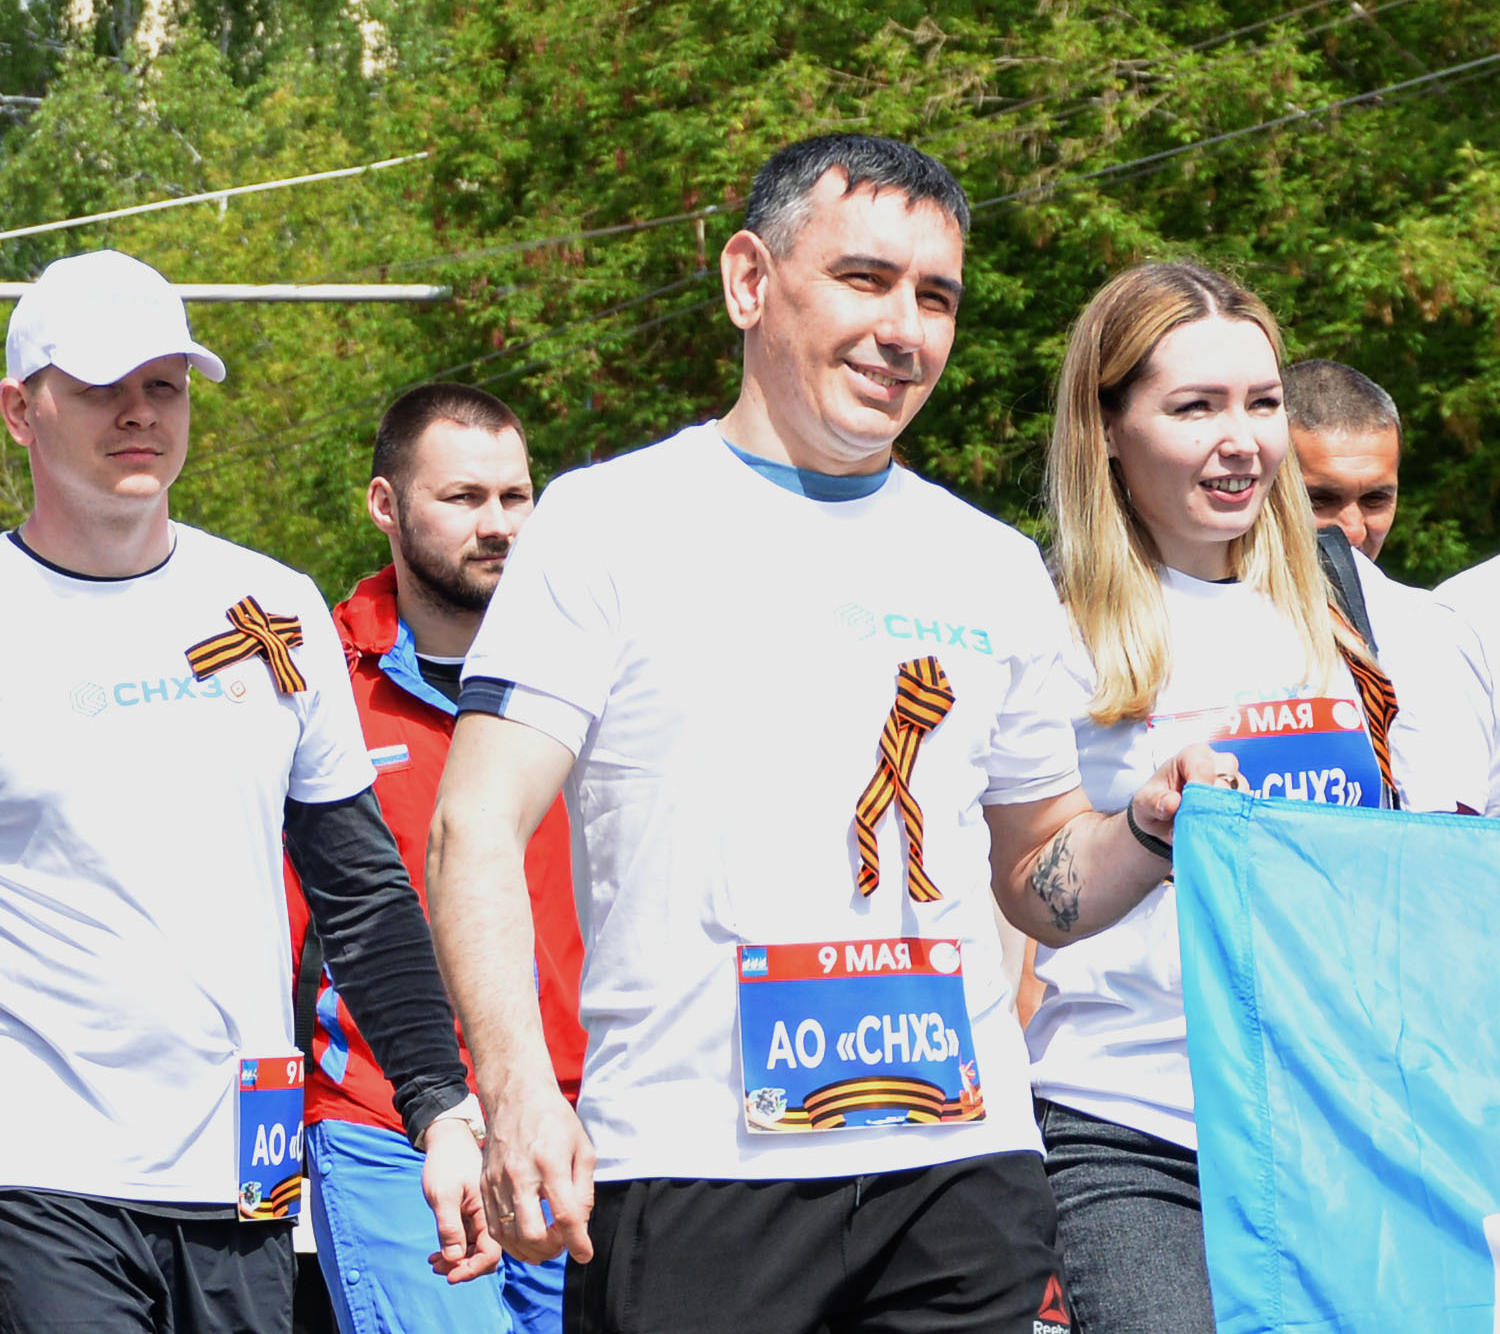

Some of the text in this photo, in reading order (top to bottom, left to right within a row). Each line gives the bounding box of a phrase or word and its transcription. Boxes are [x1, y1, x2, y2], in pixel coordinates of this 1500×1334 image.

[883, 613, 994, 655] СНХЗ
[113, 674, 224, 707] СНХЗ
[1246, 701, 1315, 734] МАЯ
[817, 942, 913, 974] 9 МАЯ
[766, 1012, 961, 1071] АО «СНХЗ»
[285, 1060, 298, 1085] 9
[251, 1122, 287, 1167] АО
